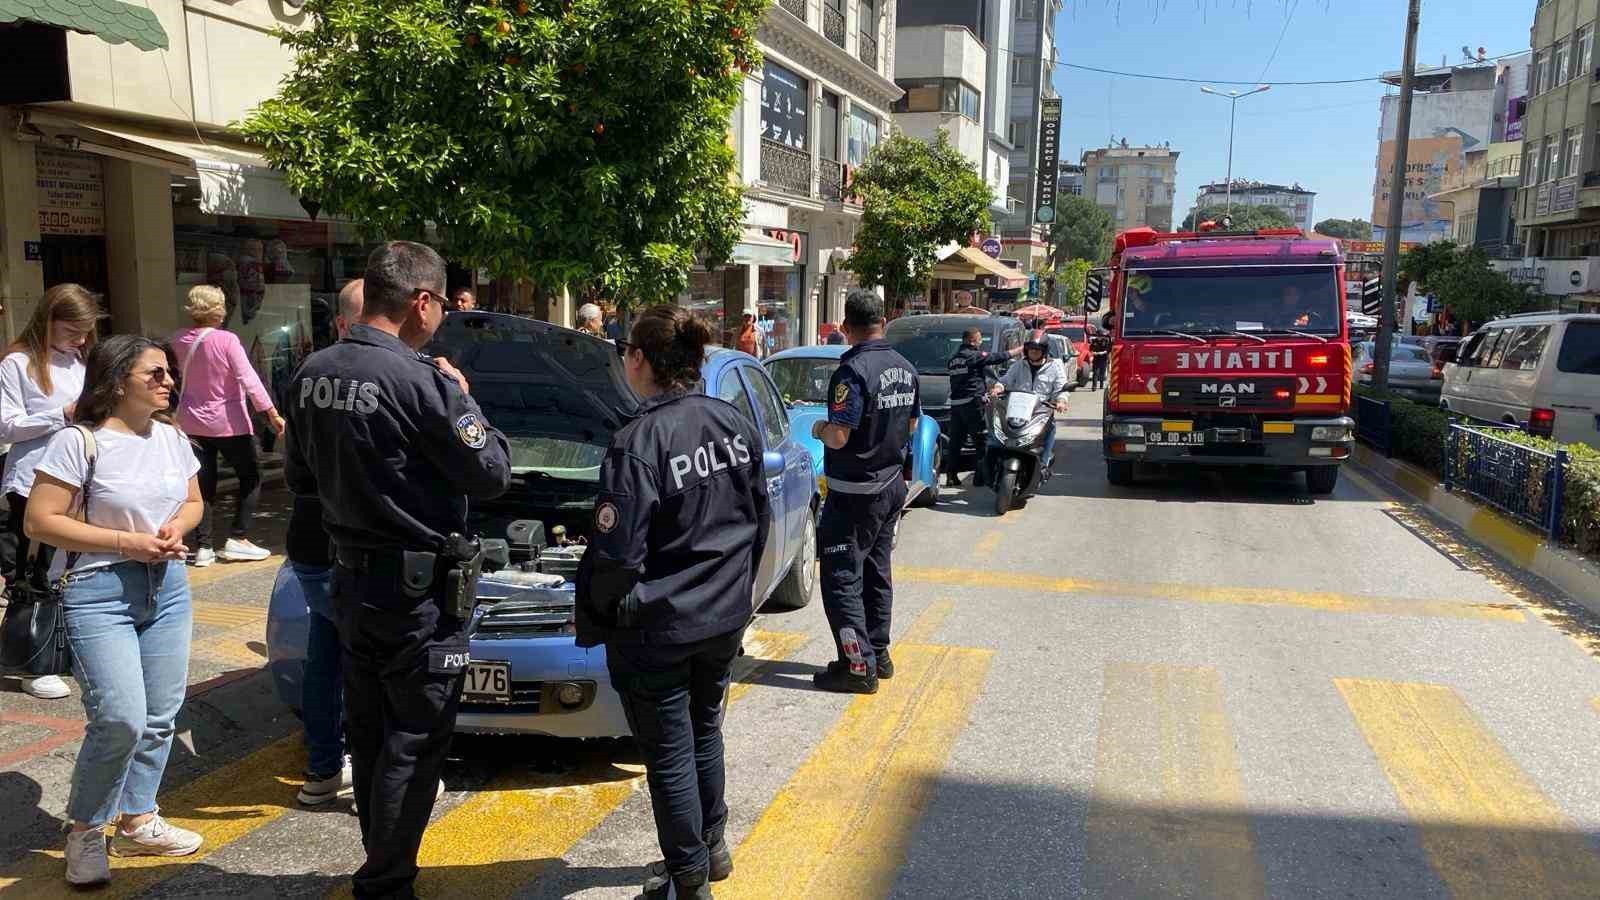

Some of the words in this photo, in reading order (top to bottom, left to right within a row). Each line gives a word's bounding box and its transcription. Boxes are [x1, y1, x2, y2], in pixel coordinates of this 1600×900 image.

[299, 376, 380, 415] POLİS
[1201, 383, 1255, 394] MAN
[669, 433, 751, 490] POLİS
[468, 667, 507, 692] 176
